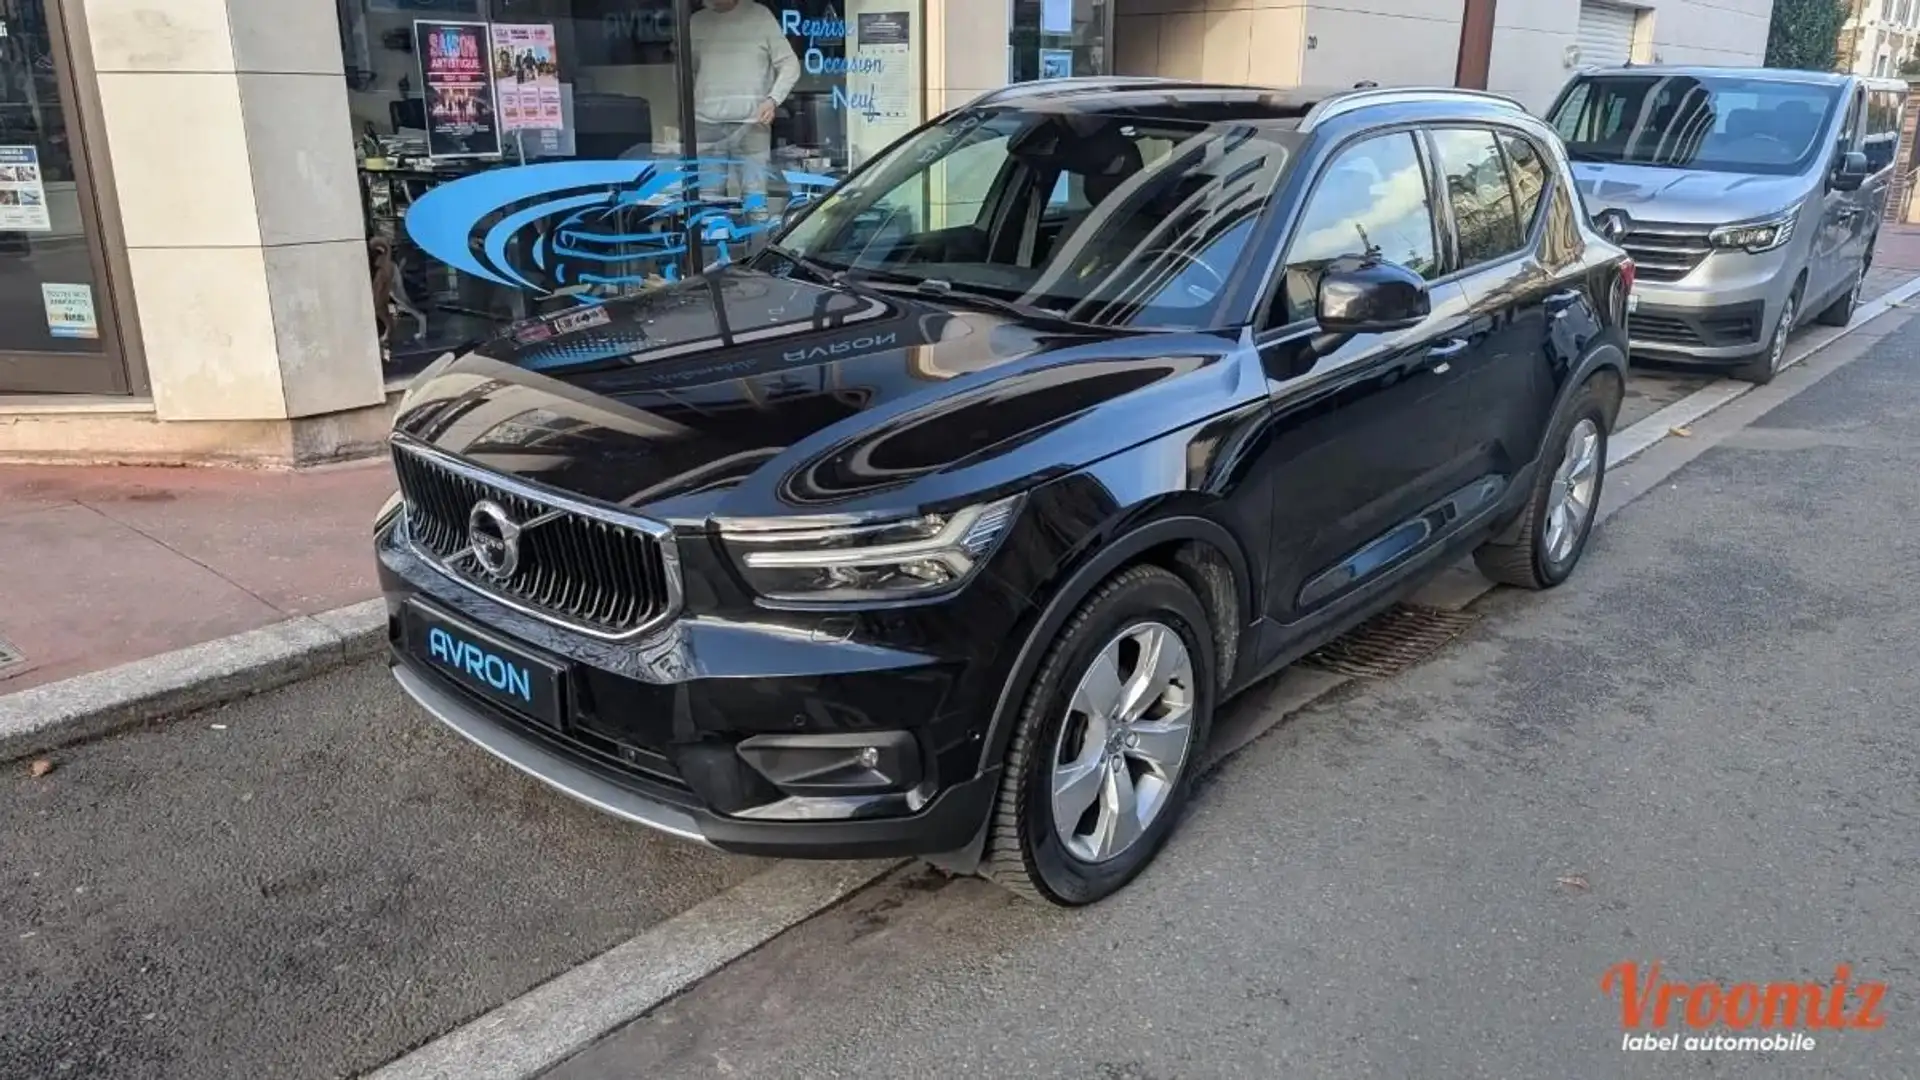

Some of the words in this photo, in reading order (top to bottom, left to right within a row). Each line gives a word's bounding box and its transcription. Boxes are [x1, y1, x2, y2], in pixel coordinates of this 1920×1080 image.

[782, 10, 856, 47] Reprise
[428, 33, 478, 58] SAISON
[805, 48, 884, 74] Occasion
[431, 58, 481, 69] ARTISTIQUE
[832, 84, 881, 122] Neuf
[428, 627, 532, 703] AVRON
